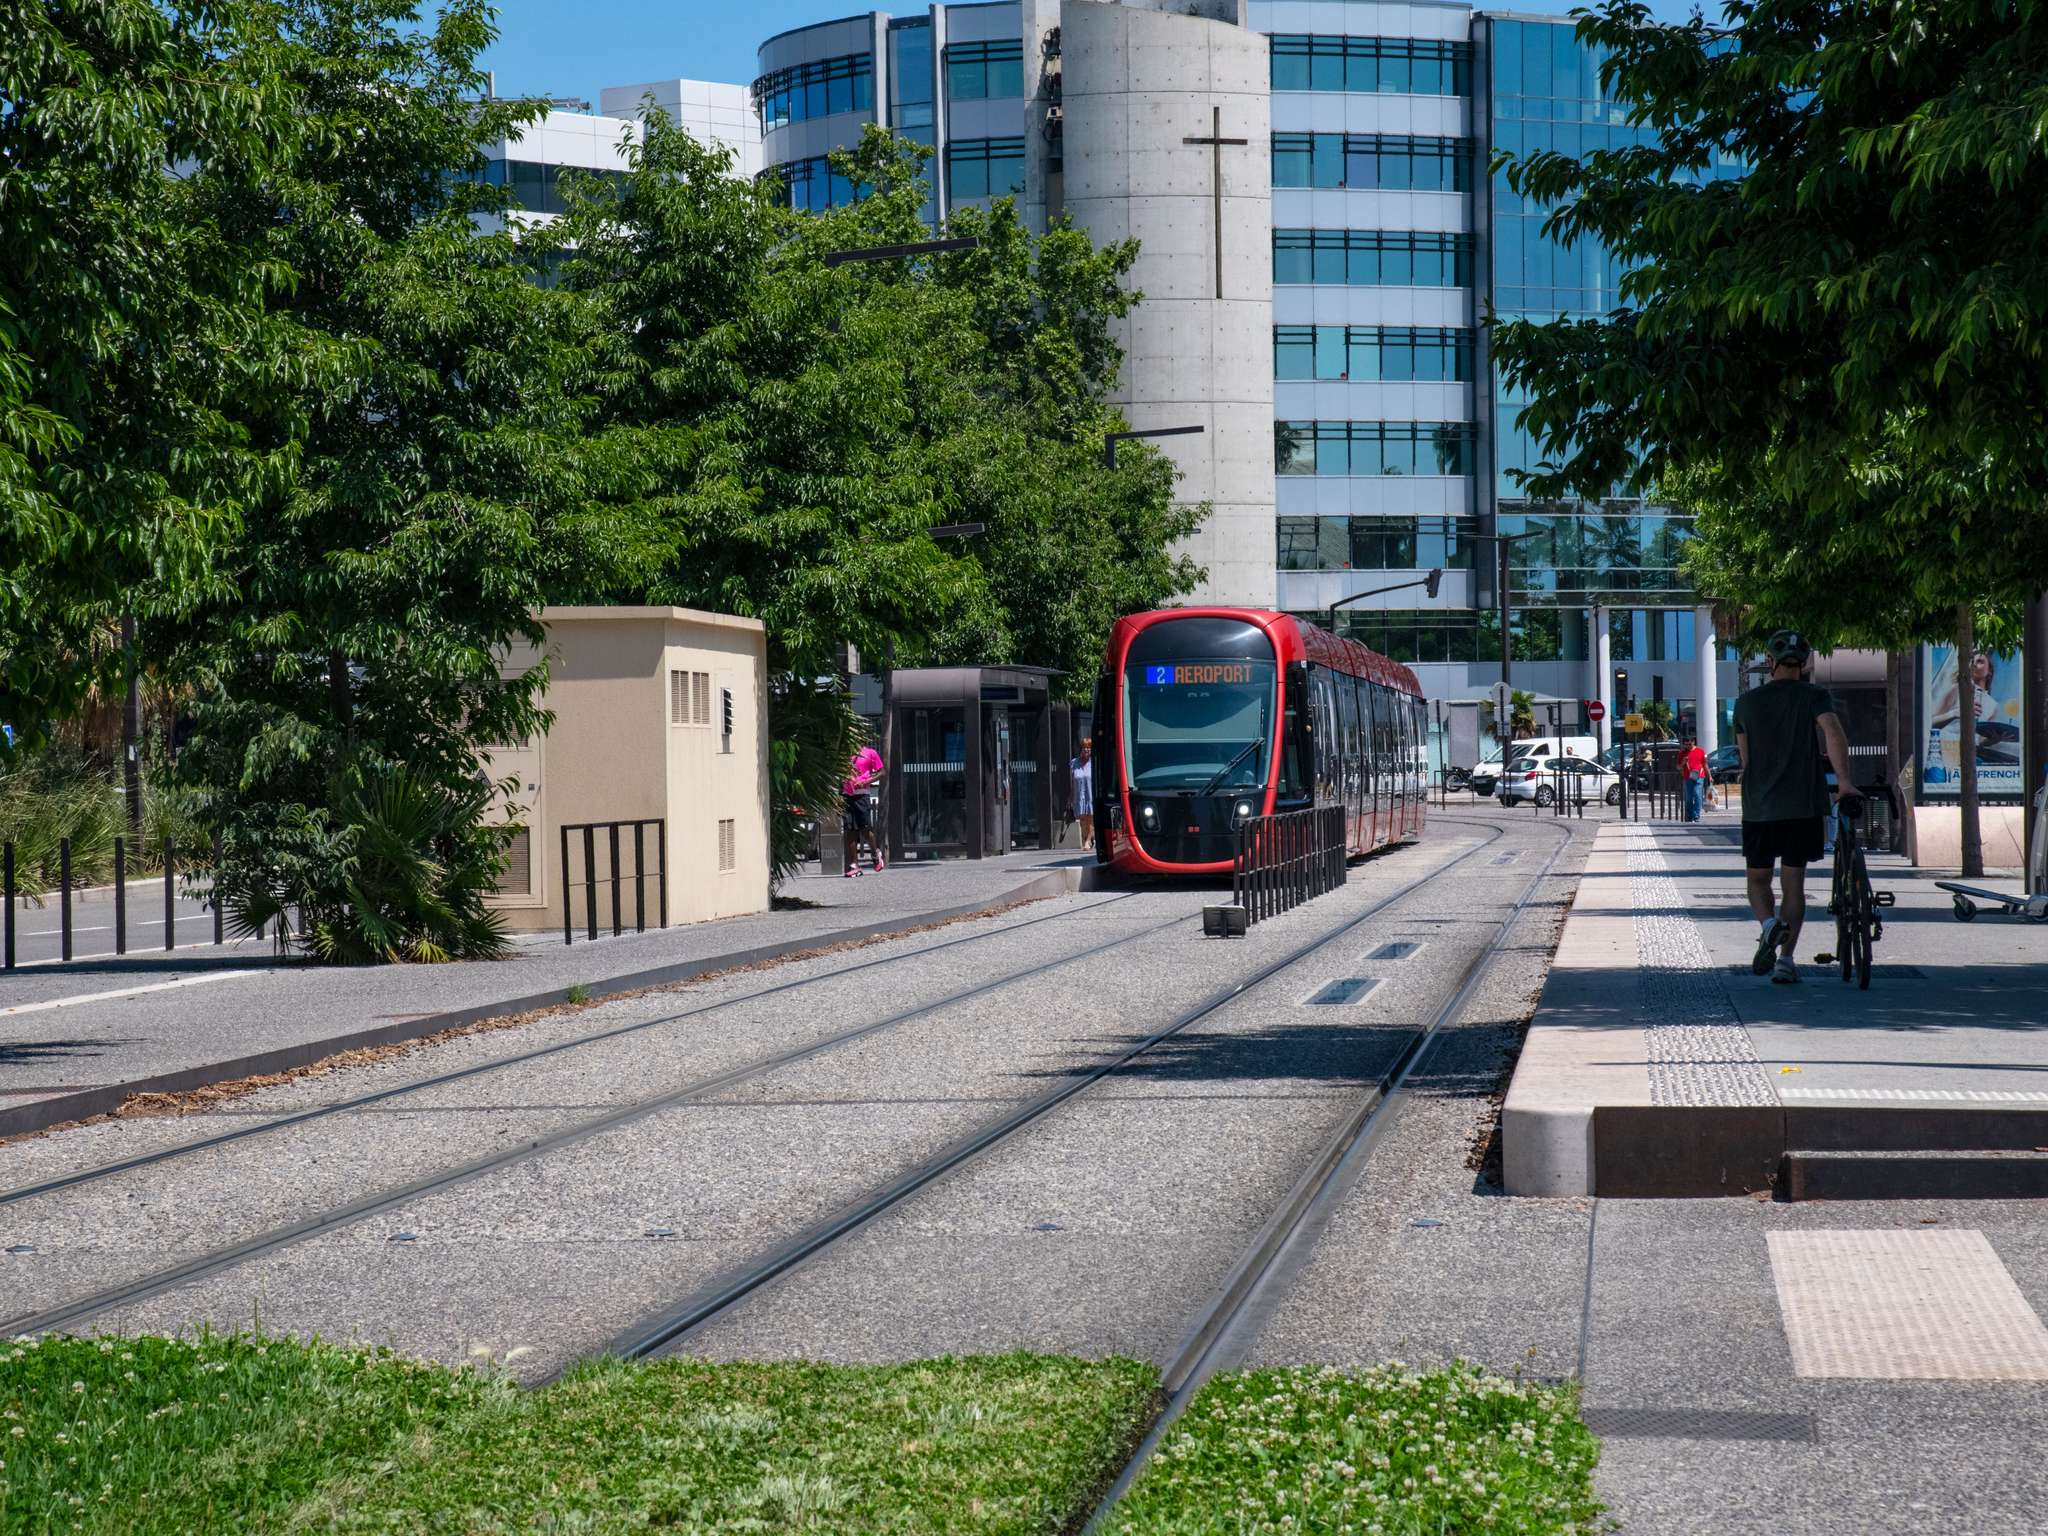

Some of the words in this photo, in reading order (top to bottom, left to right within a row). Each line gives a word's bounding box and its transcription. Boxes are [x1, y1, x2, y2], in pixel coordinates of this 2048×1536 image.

[1157, 666, 1165, 684] 2
[1175, 665, 1251, 684] AEROPORT
[1977, 770, 2020, 779] FRENCH
